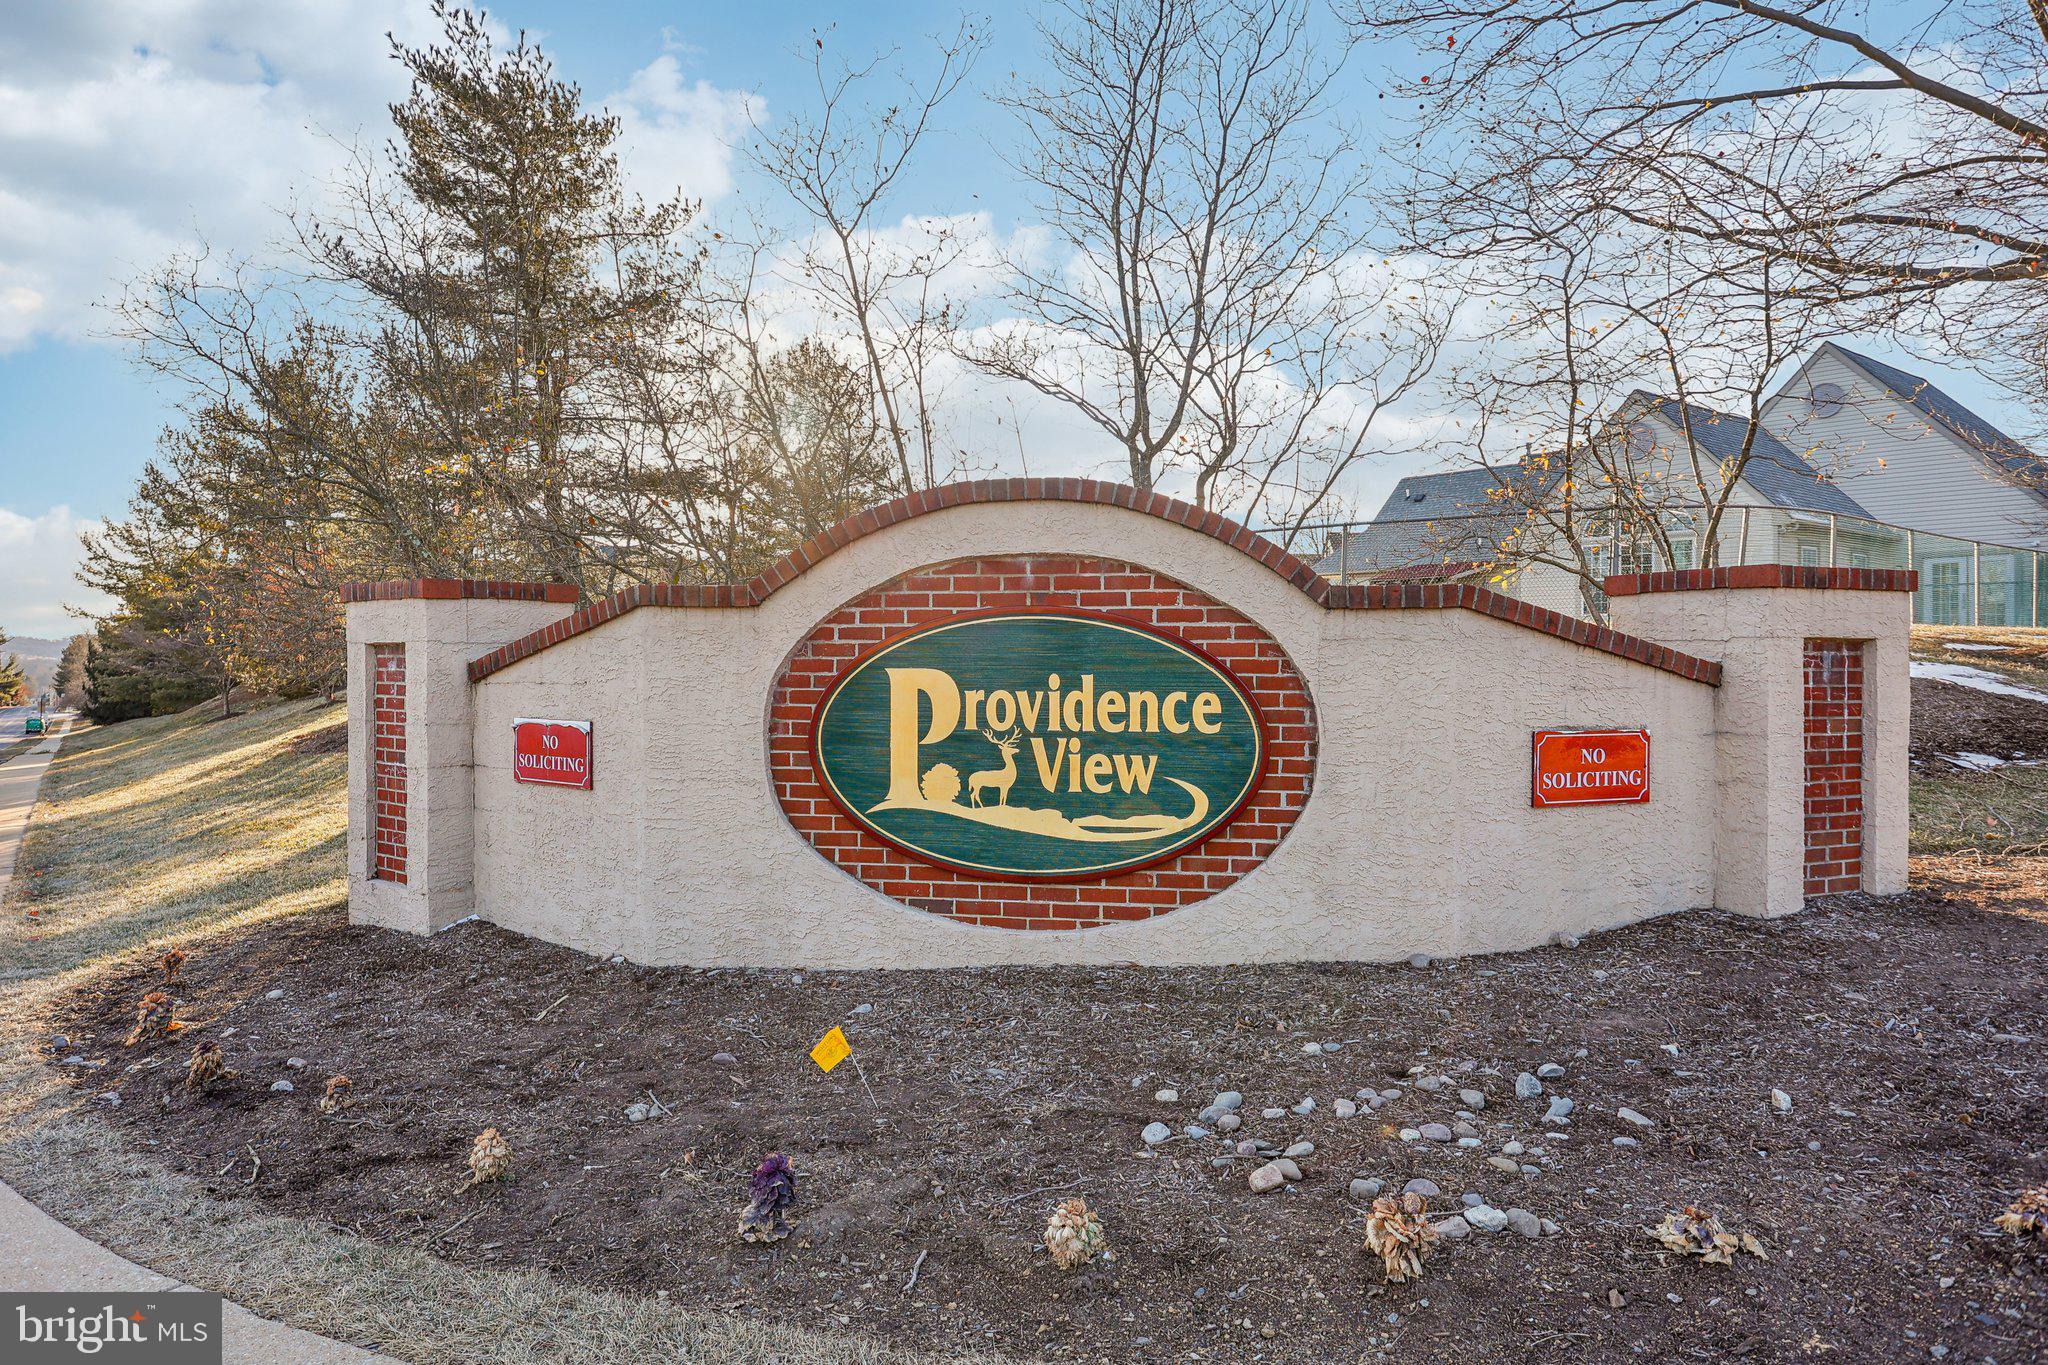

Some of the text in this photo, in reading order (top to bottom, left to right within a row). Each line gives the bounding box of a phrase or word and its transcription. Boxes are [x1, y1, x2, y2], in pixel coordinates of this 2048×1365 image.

[542, 734, 559, 750] NO
[884, 667, 1223, 801] Providence
[518, 753, 584, 773] SOLICITING
[1030, 736, 1159, 794] View
[1580, 748, 1606, 765] NO
[1542, 769, 1642, 789] SOLICITING
